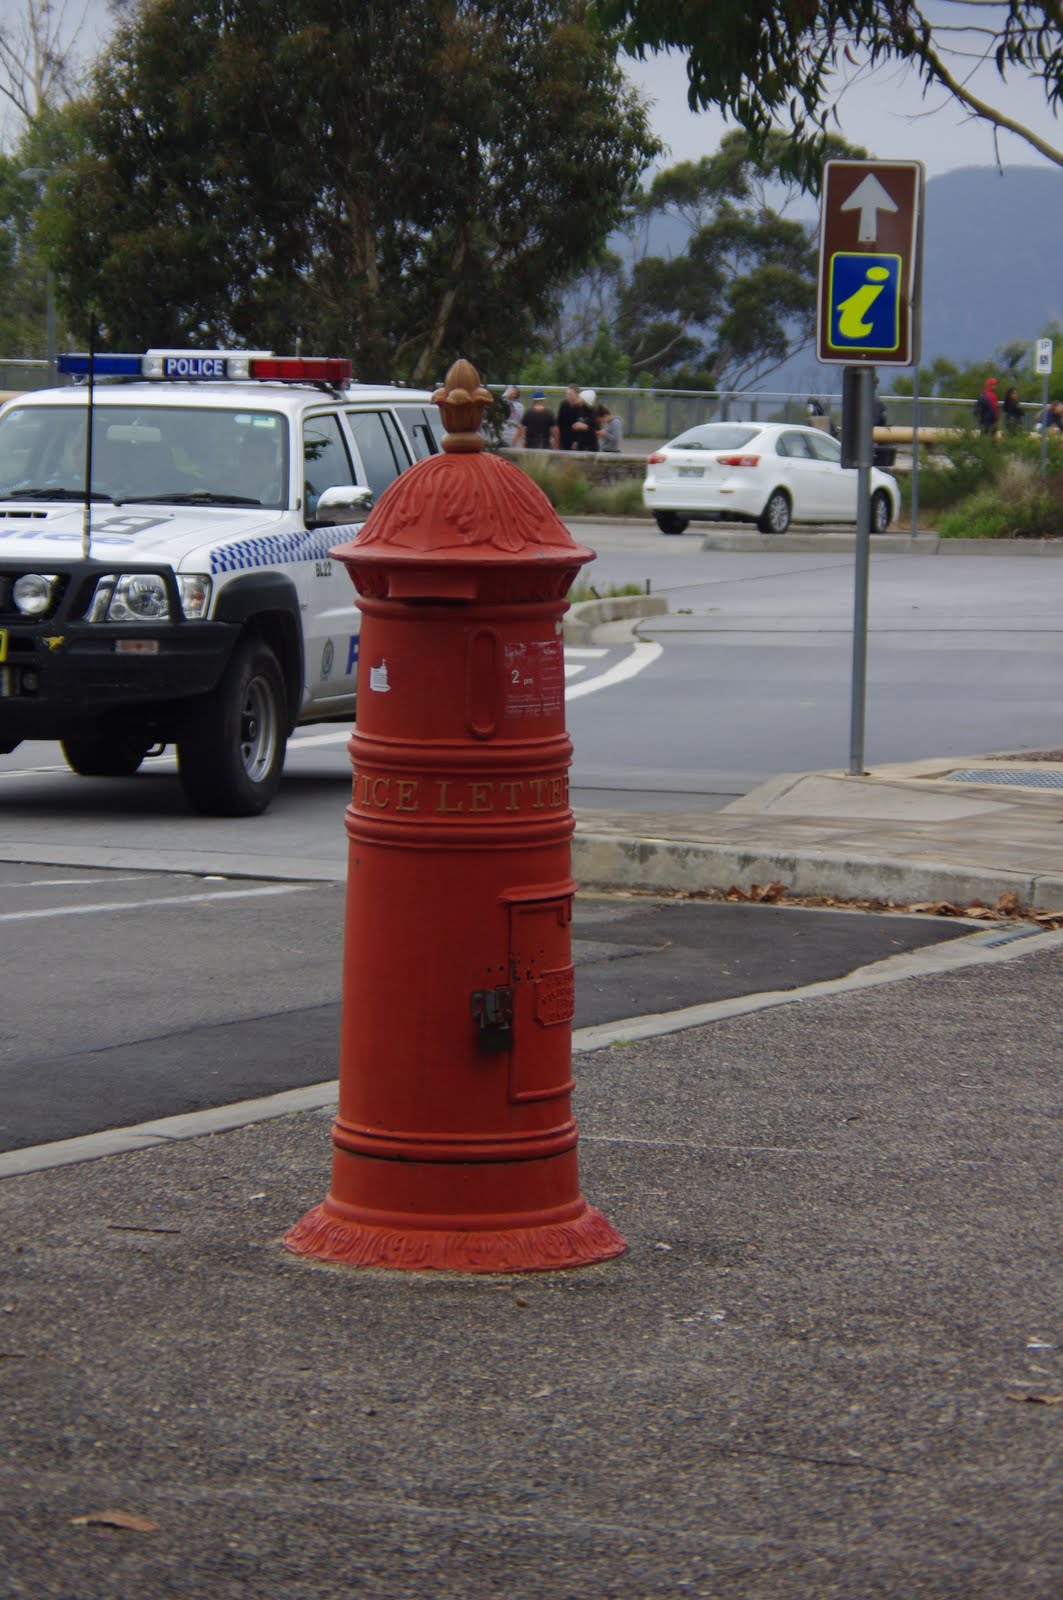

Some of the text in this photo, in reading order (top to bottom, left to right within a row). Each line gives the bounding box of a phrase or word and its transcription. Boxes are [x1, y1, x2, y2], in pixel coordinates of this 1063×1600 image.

[167, 358, 223, 376] POLICE
[511, 669, 533, 686] 2 pm
